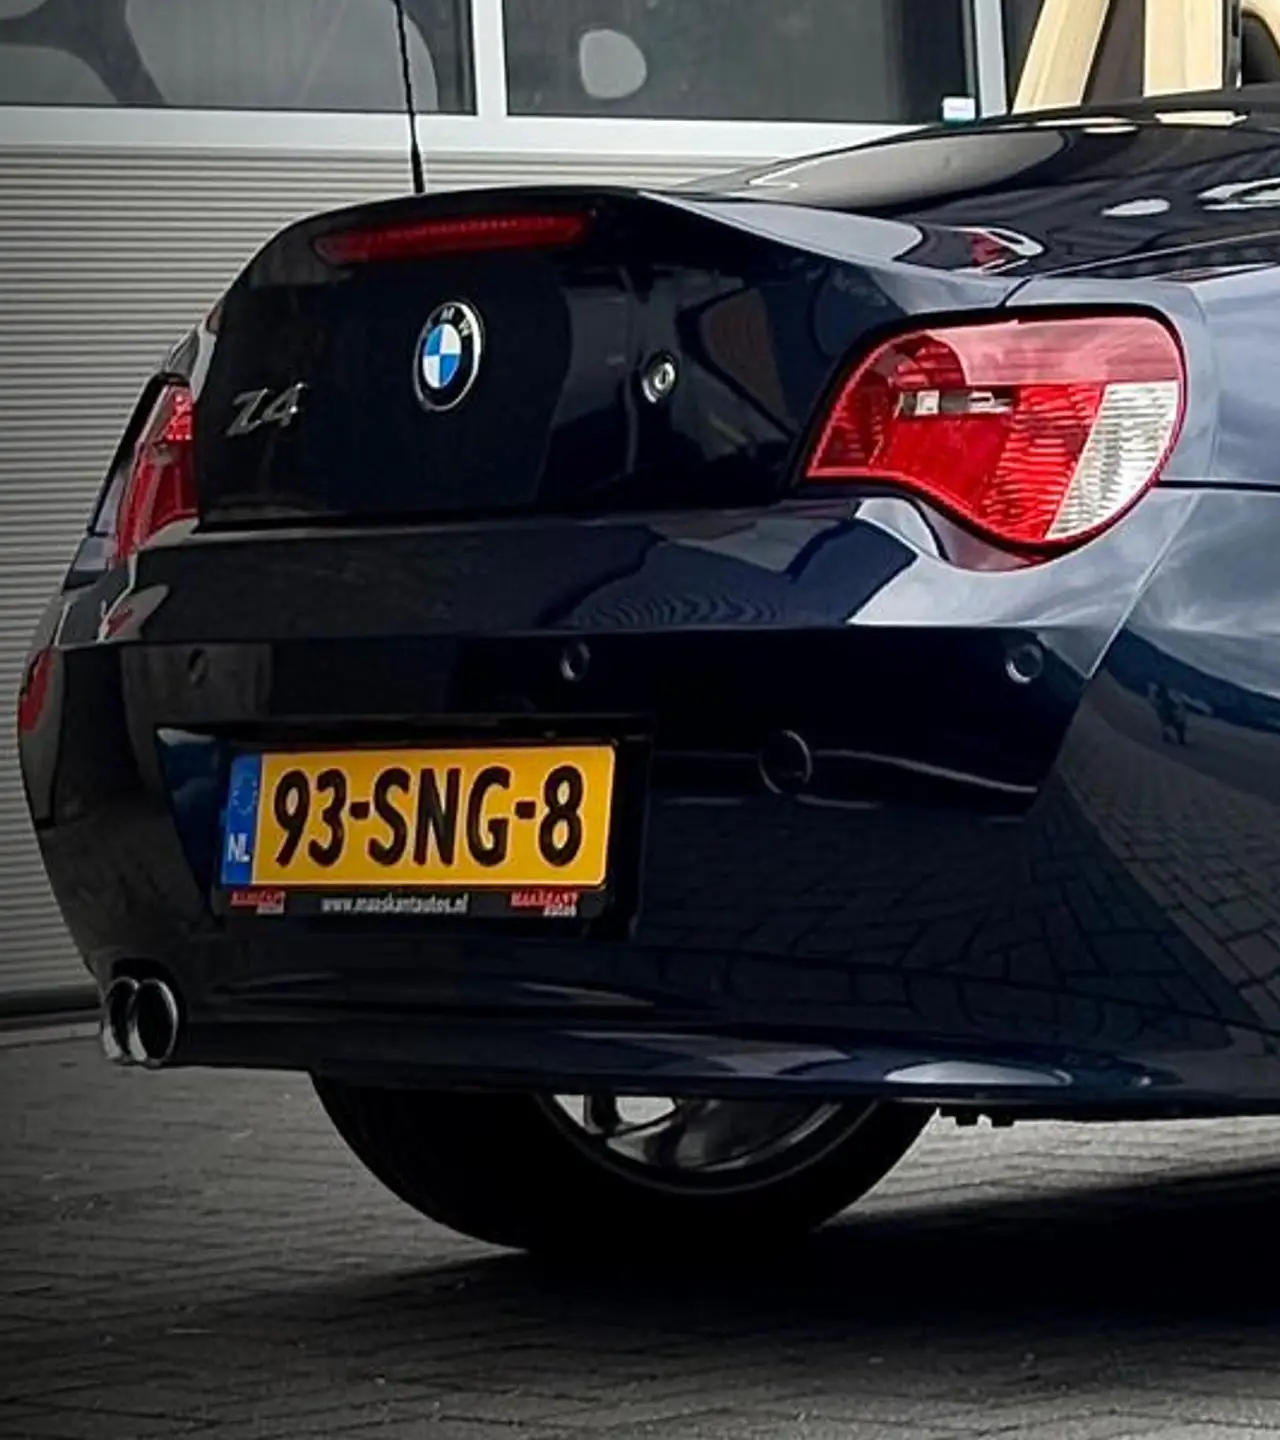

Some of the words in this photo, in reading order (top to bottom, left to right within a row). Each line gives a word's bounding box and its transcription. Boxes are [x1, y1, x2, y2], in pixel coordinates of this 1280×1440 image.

[225, 382, 308, 437] Z4
[273, 765, 583, 868] 93-SNG-8
[227, 833, 251, 863] NL
